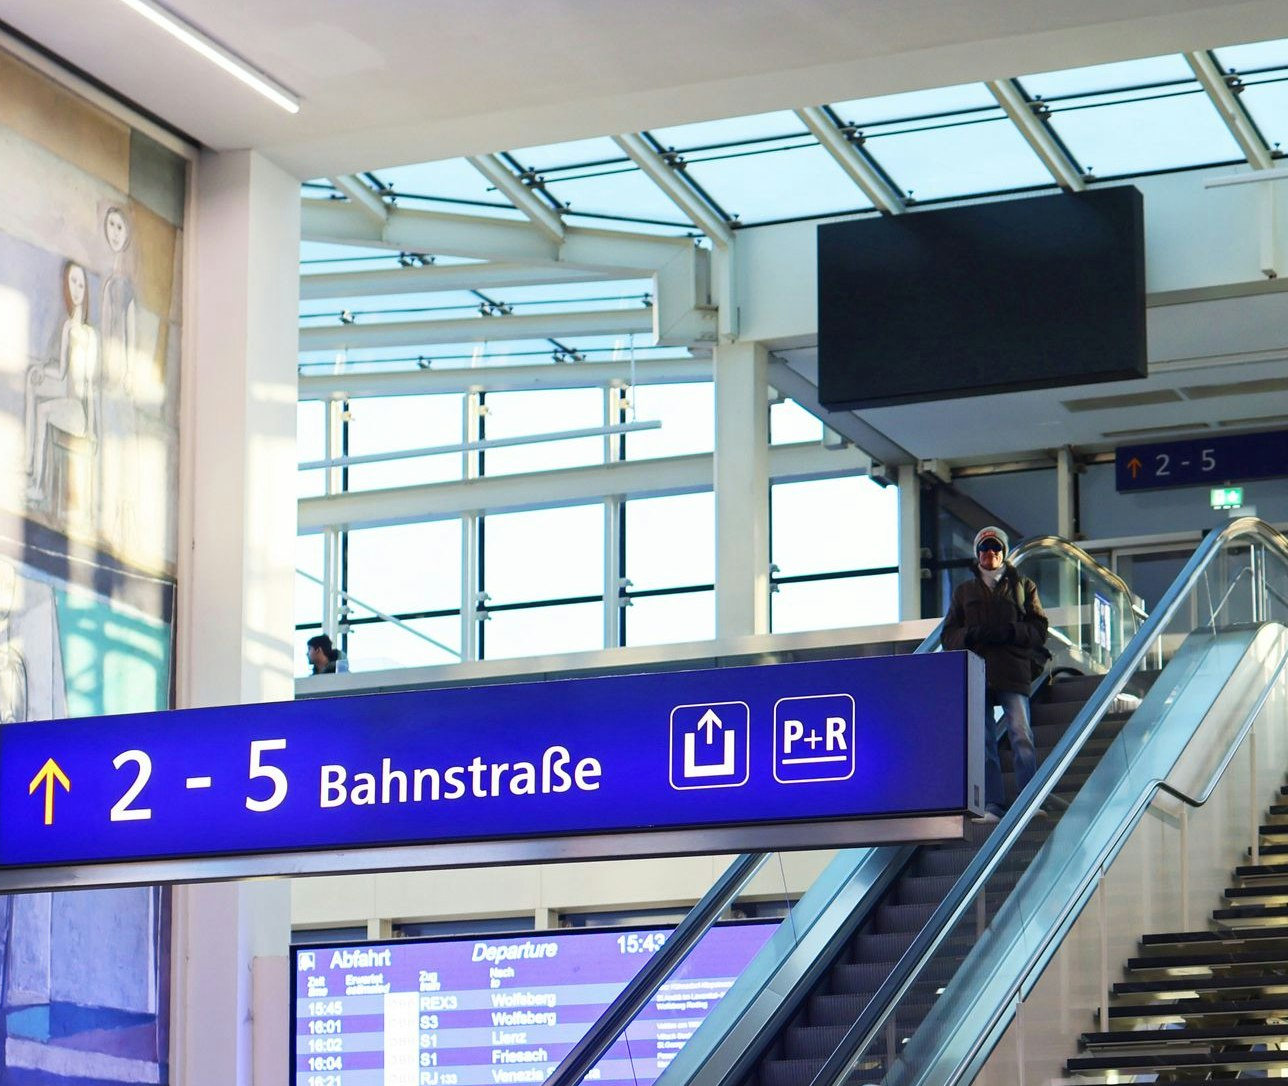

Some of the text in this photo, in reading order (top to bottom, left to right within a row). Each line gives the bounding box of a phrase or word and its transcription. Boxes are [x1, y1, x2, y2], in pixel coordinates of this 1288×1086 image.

[1155, 453, 1170, 476] 2
[1201, 448, 1217, 471] 5
[783, 717, 848, 754] P+R
[110, 738, 602, 821] 2 - 5 Bahnstraße
[330, 933, 666, 969] Abfahrt Departure 15:43
[308, 993, 557, 1016] 15:45 REX3 Wolfsberg
[308, 1011, 557, 1035] 16:01 S3 Wolfsberg
[420, 1034, 437, 1048] S1
[491, 1031, 527, 1046] Lienz
[420, 1052, 437, 1066] S1
[491, 1048, 548, 1064] Friesach
[420, 1072, 438, 1086] RJ
[491, 1069, 544, 1083] Venezia
